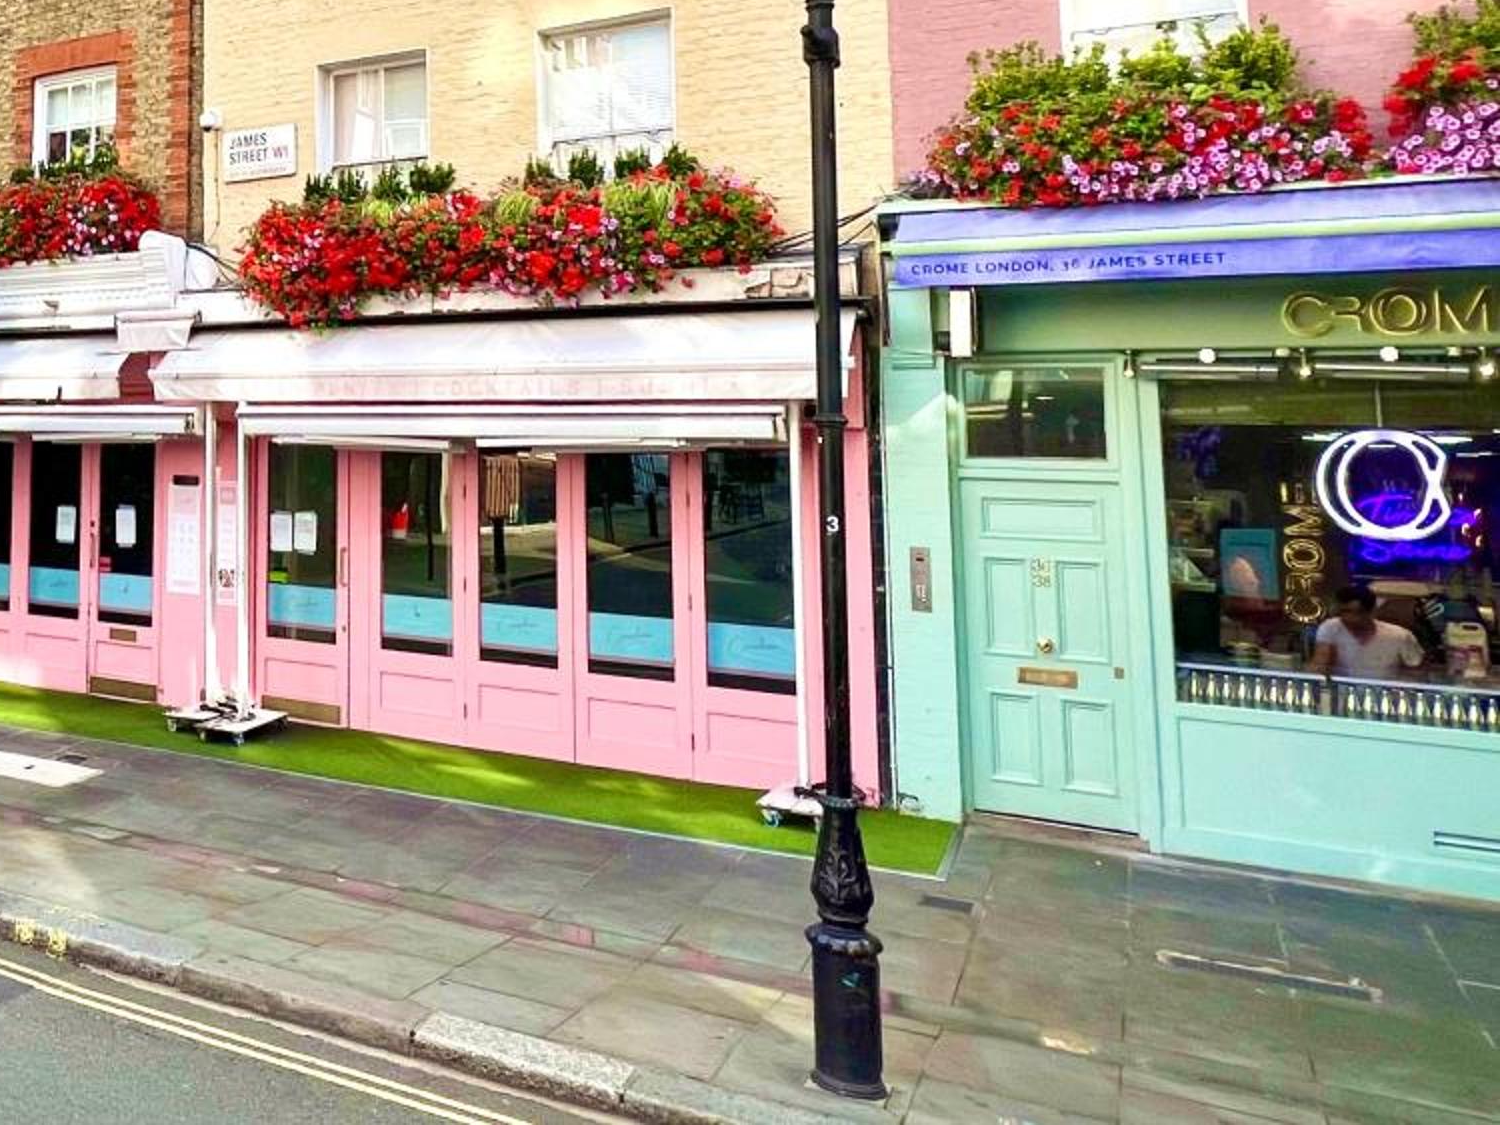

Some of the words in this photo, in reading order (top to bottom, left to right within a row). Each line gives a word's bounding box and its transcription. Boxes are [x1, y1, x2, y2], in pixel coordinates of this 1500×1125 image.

[229, 132, 267, 149] JAMES
[229, 147, 268, 165] STREET
[911, 263, 969, 275] CROME
[1086, 255, 1147, 269] JAMES
[1154, 252, 1225, 266] STREET
[826, 516, 839, 532] 3
